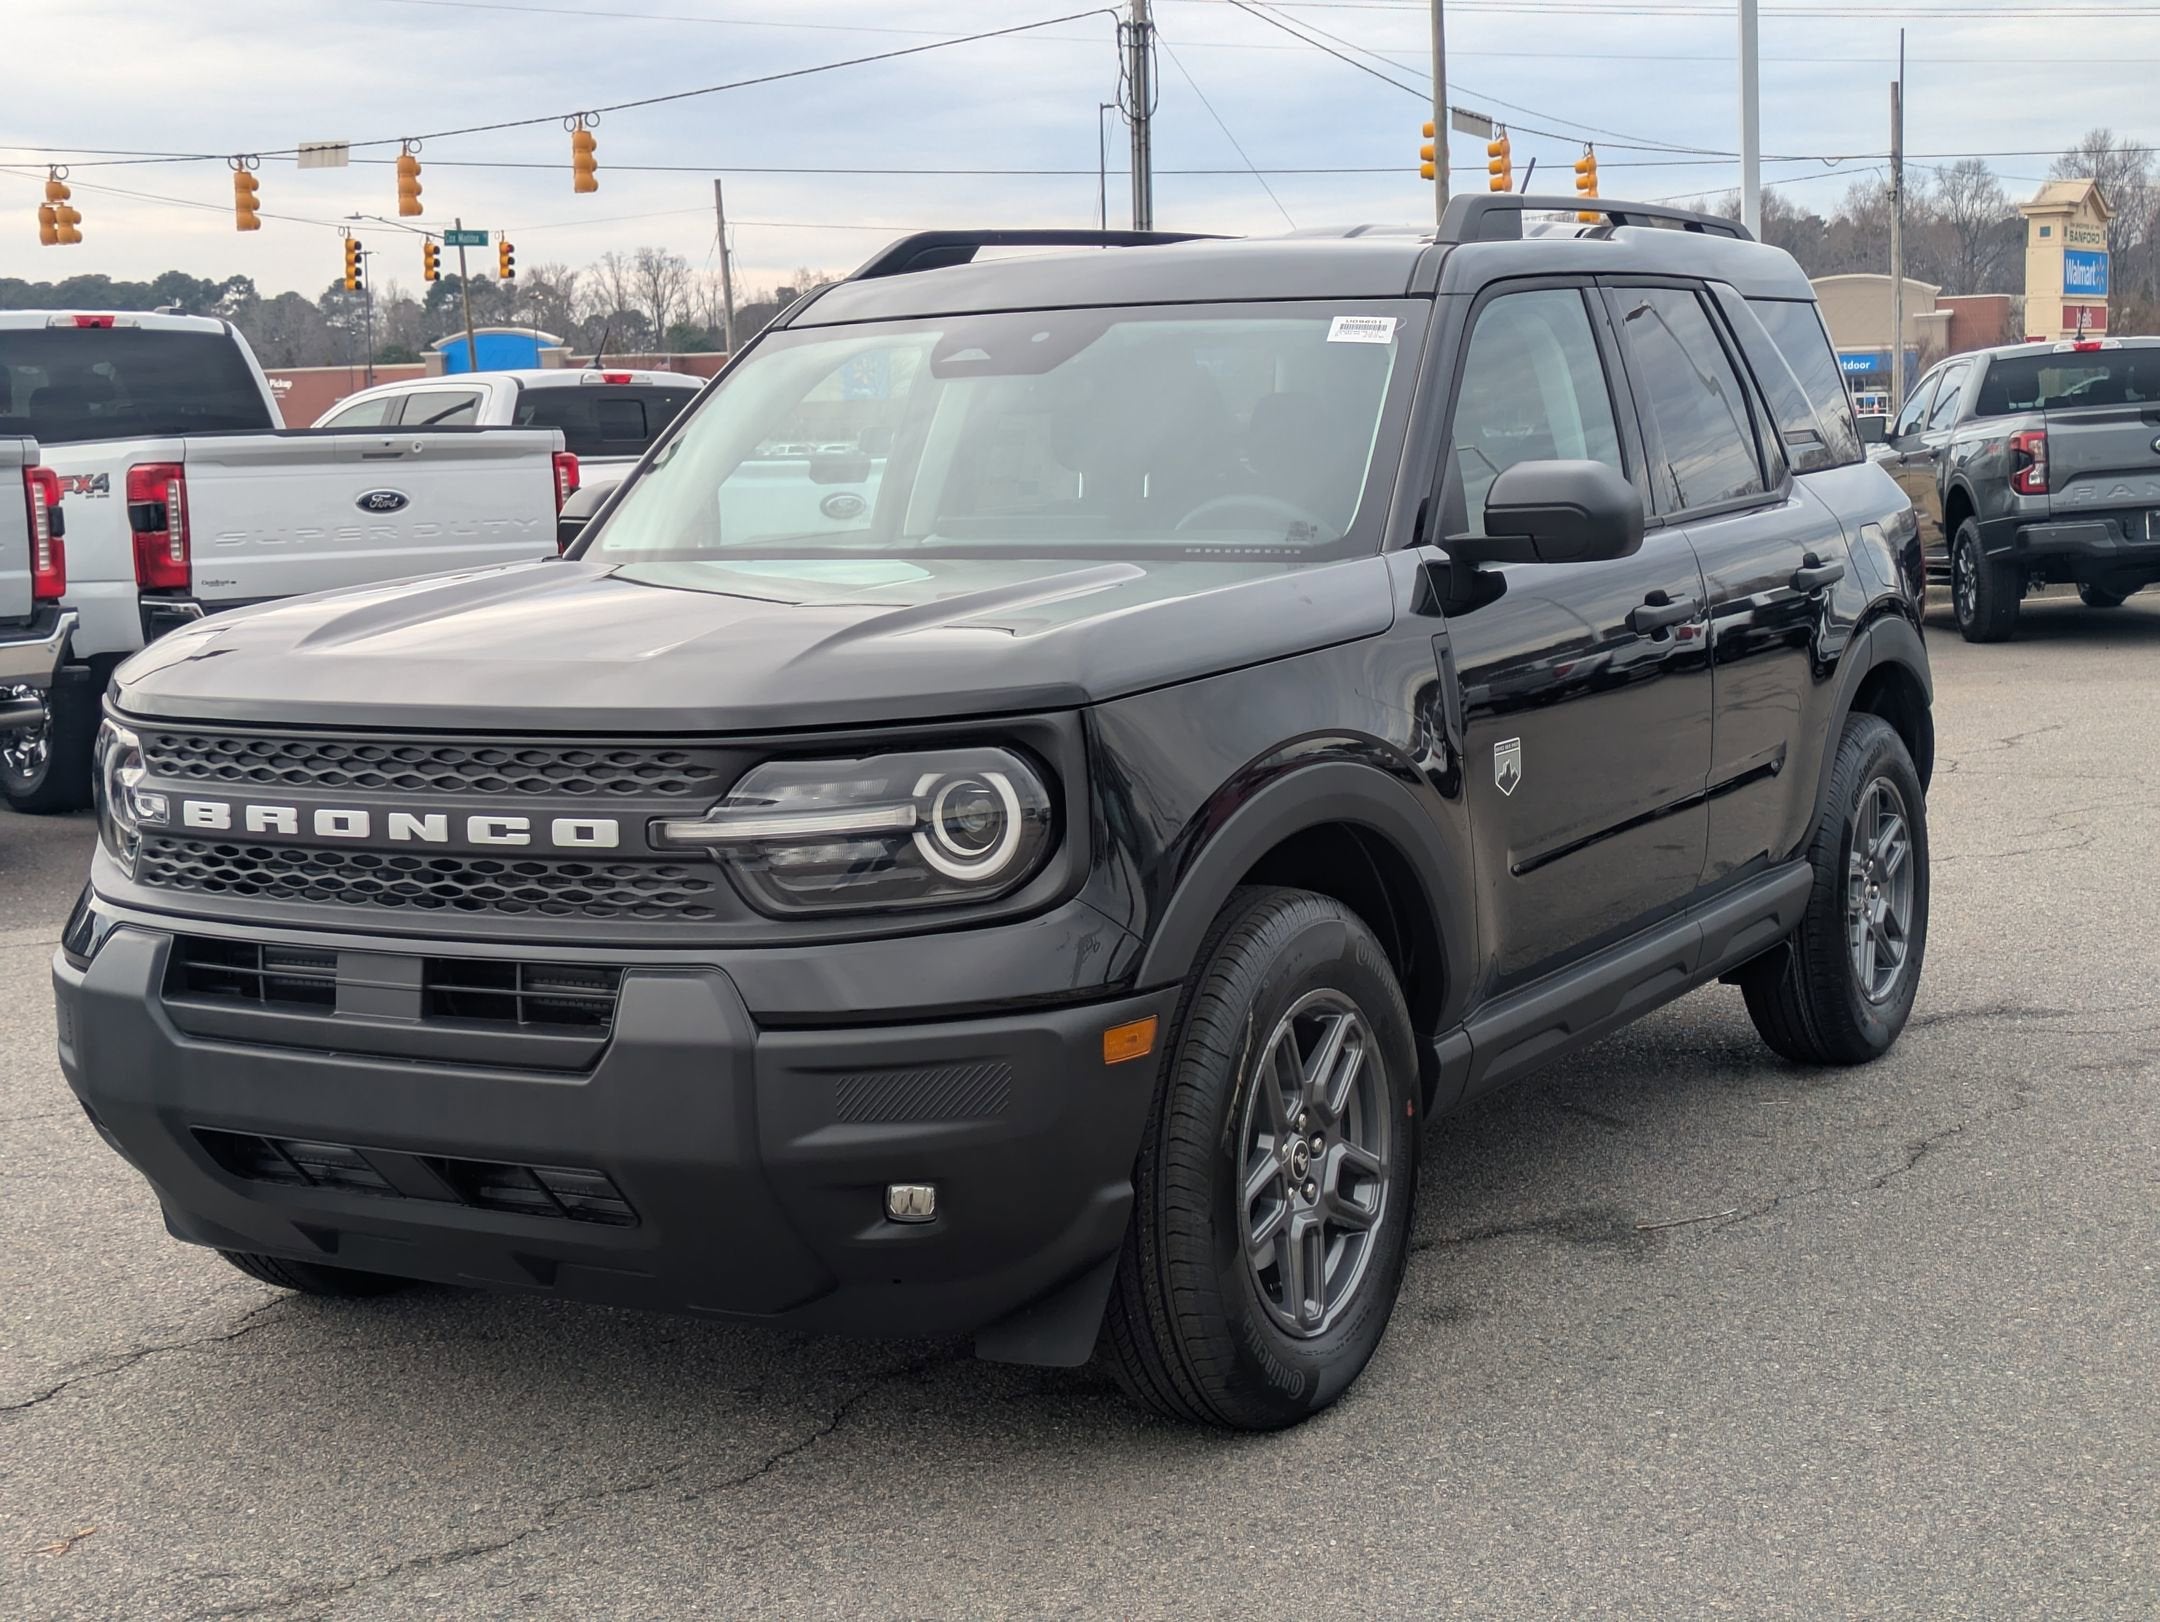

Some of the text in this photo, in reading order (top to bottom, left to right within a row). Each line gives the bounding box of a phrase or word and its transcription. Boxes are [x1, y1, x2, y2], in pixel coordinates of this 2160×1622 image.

[2069, 230, 2100, 244] SANFORD
[2066, 259, 2096, 286] Walmart
[1842, 360, 1870, 370] tdoor
[57, 473, 110, 500] FX4
[369, 493, 398, 509] Ford
[215, 517, 539, 548] SUPER DUTY
[183, 800, 620, 848] BRONCO
